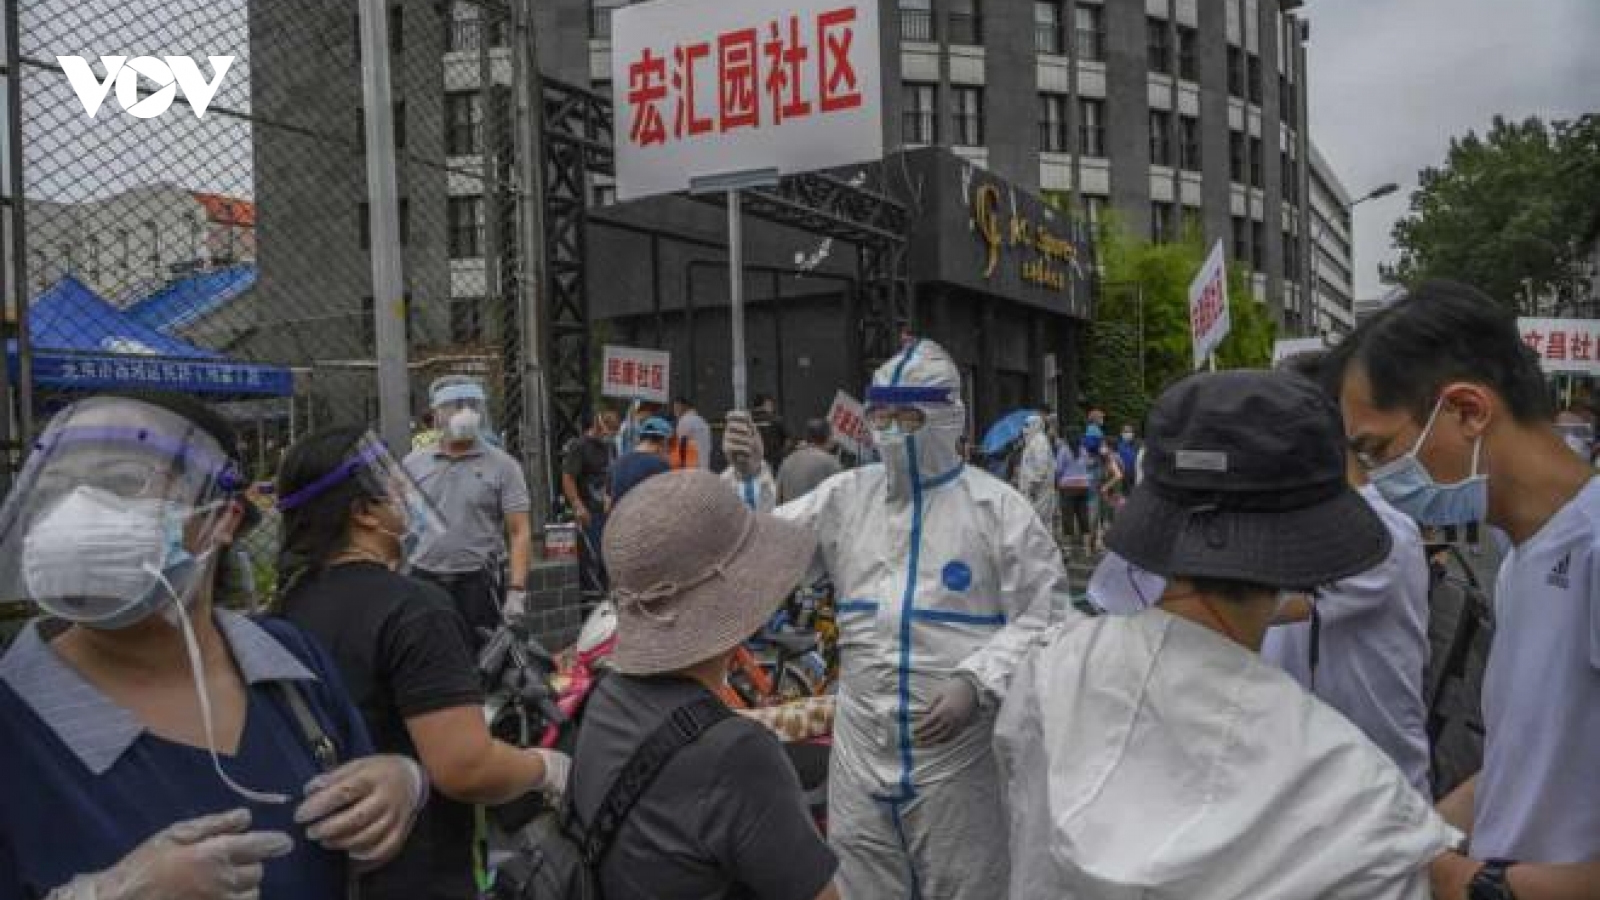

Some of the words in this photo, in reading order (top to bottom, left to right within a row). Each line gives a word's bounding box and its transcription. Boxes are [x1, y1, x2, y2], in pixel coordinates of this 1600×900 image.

[628, 8, 862, 147] 宏汇园社区
[1524, 330, 1600, 361] 文昌社
